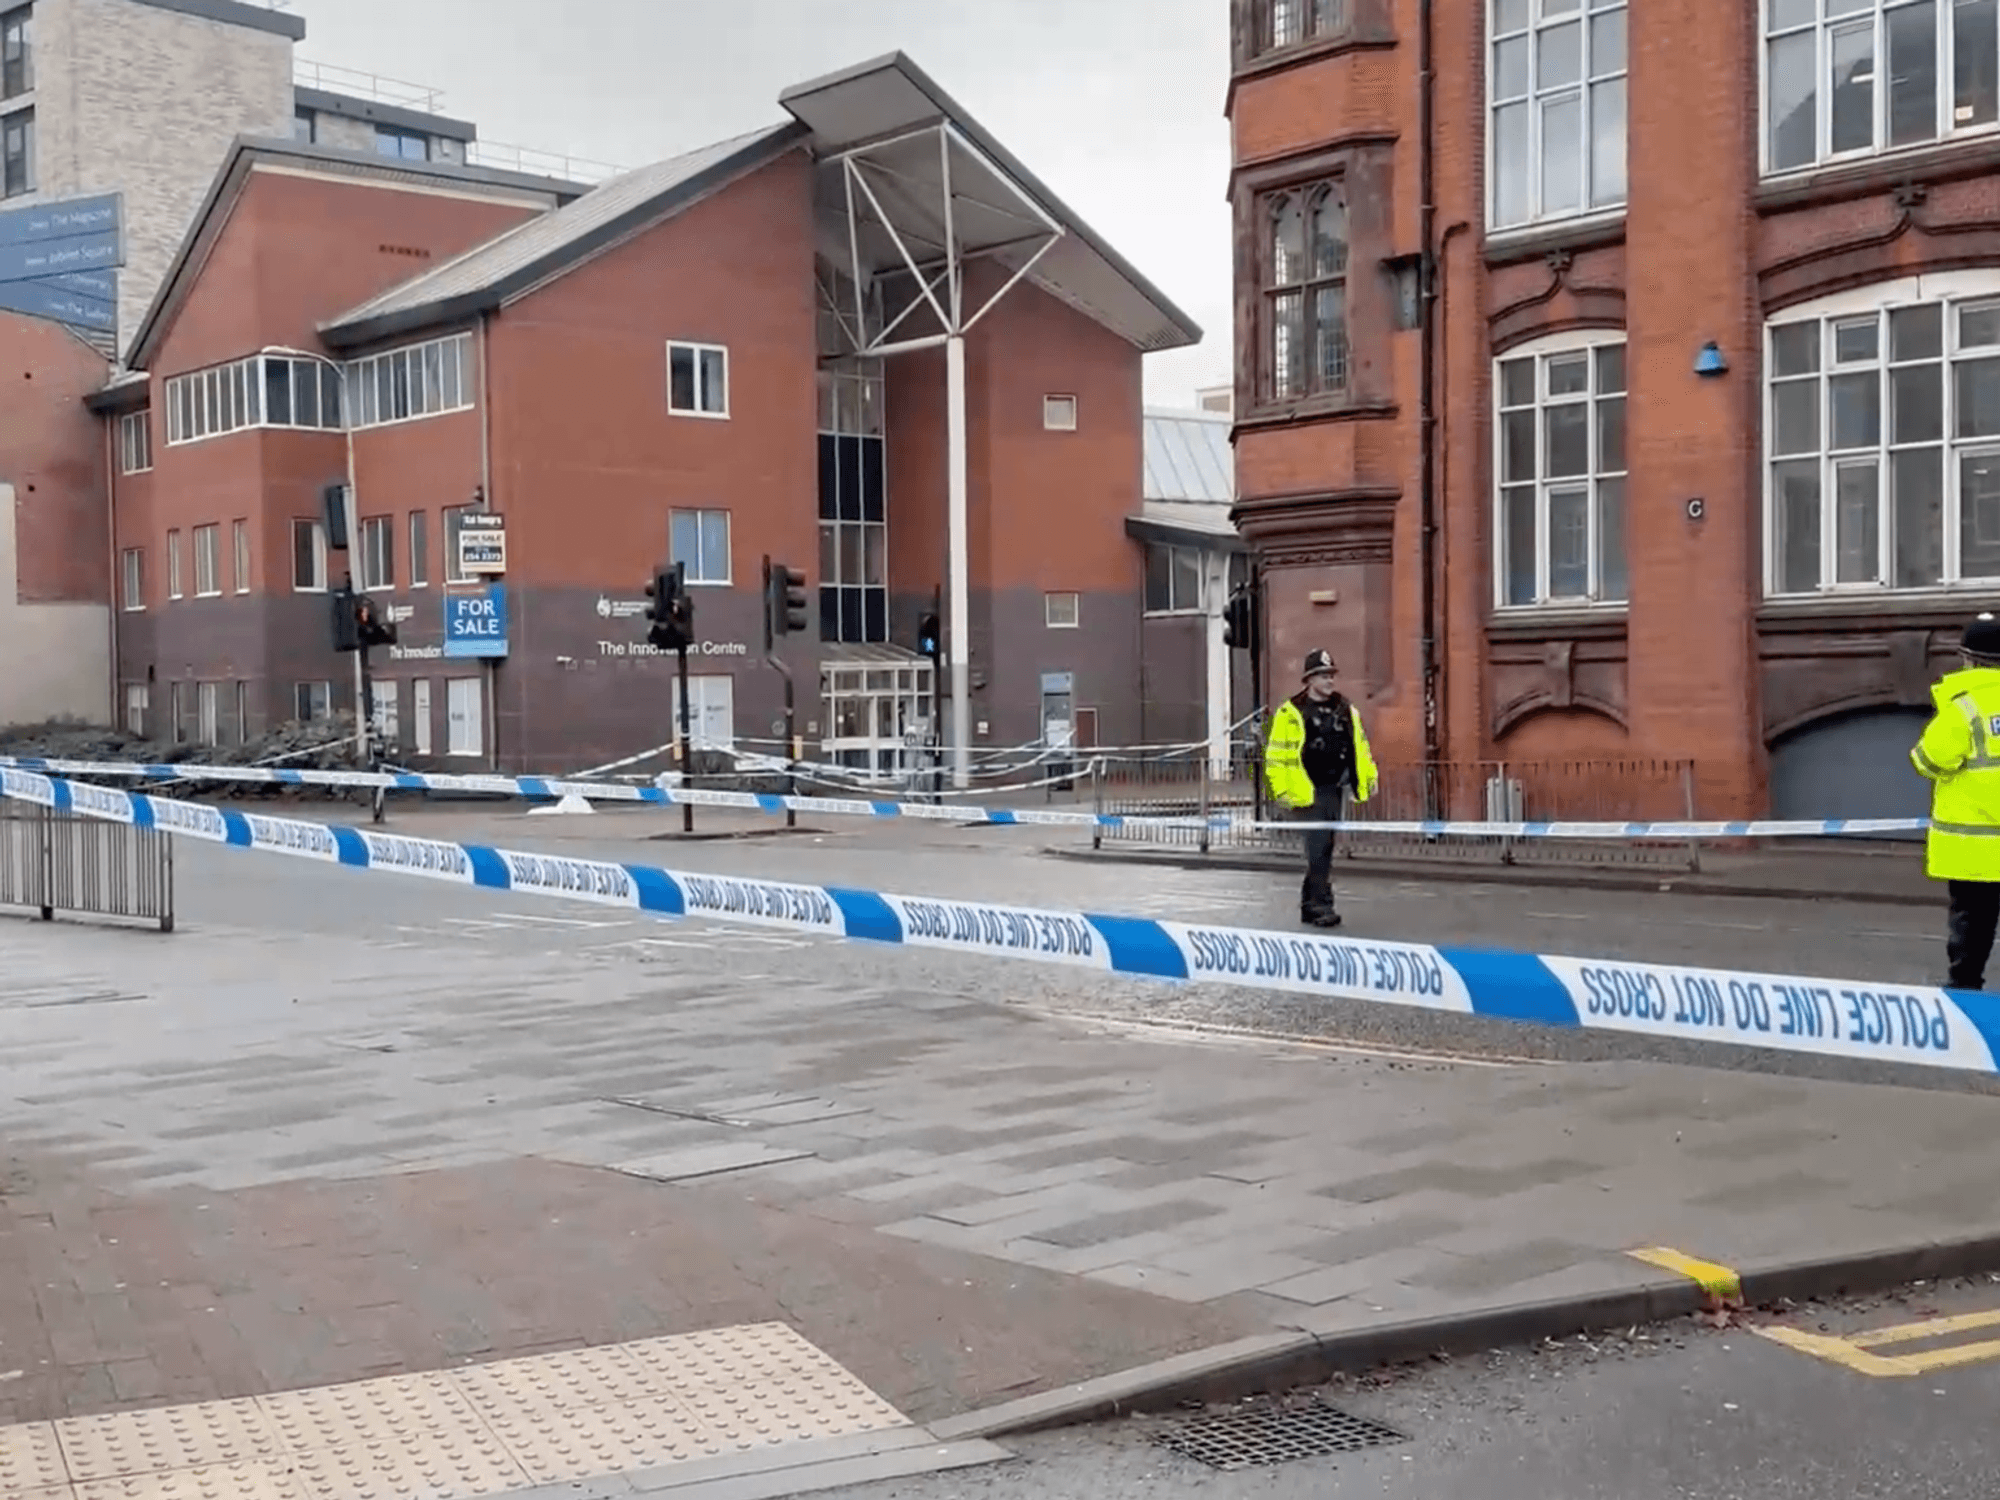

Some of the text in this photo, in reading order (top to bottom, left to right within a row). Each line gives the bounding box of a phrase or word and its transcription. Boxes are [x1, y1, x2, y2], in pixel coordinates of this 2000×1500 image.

[453, 619, 500, 635] SALE
[458, 600, 496, 617] FOR
[597, 641, 625, 655] The
[701, 640, 747, 655] Centre
[683, 876, 832, 924] POLICE LINE DO NOT CROSS
[902, 900, 1093, 956] POLICE LINE DO NOT CROSS
[1187, 929, 1443, 996] POLICE LINE DO NOT CROSS
[1580, 966, 1950, 1051] POLICE LINE DO NOT CROSS
